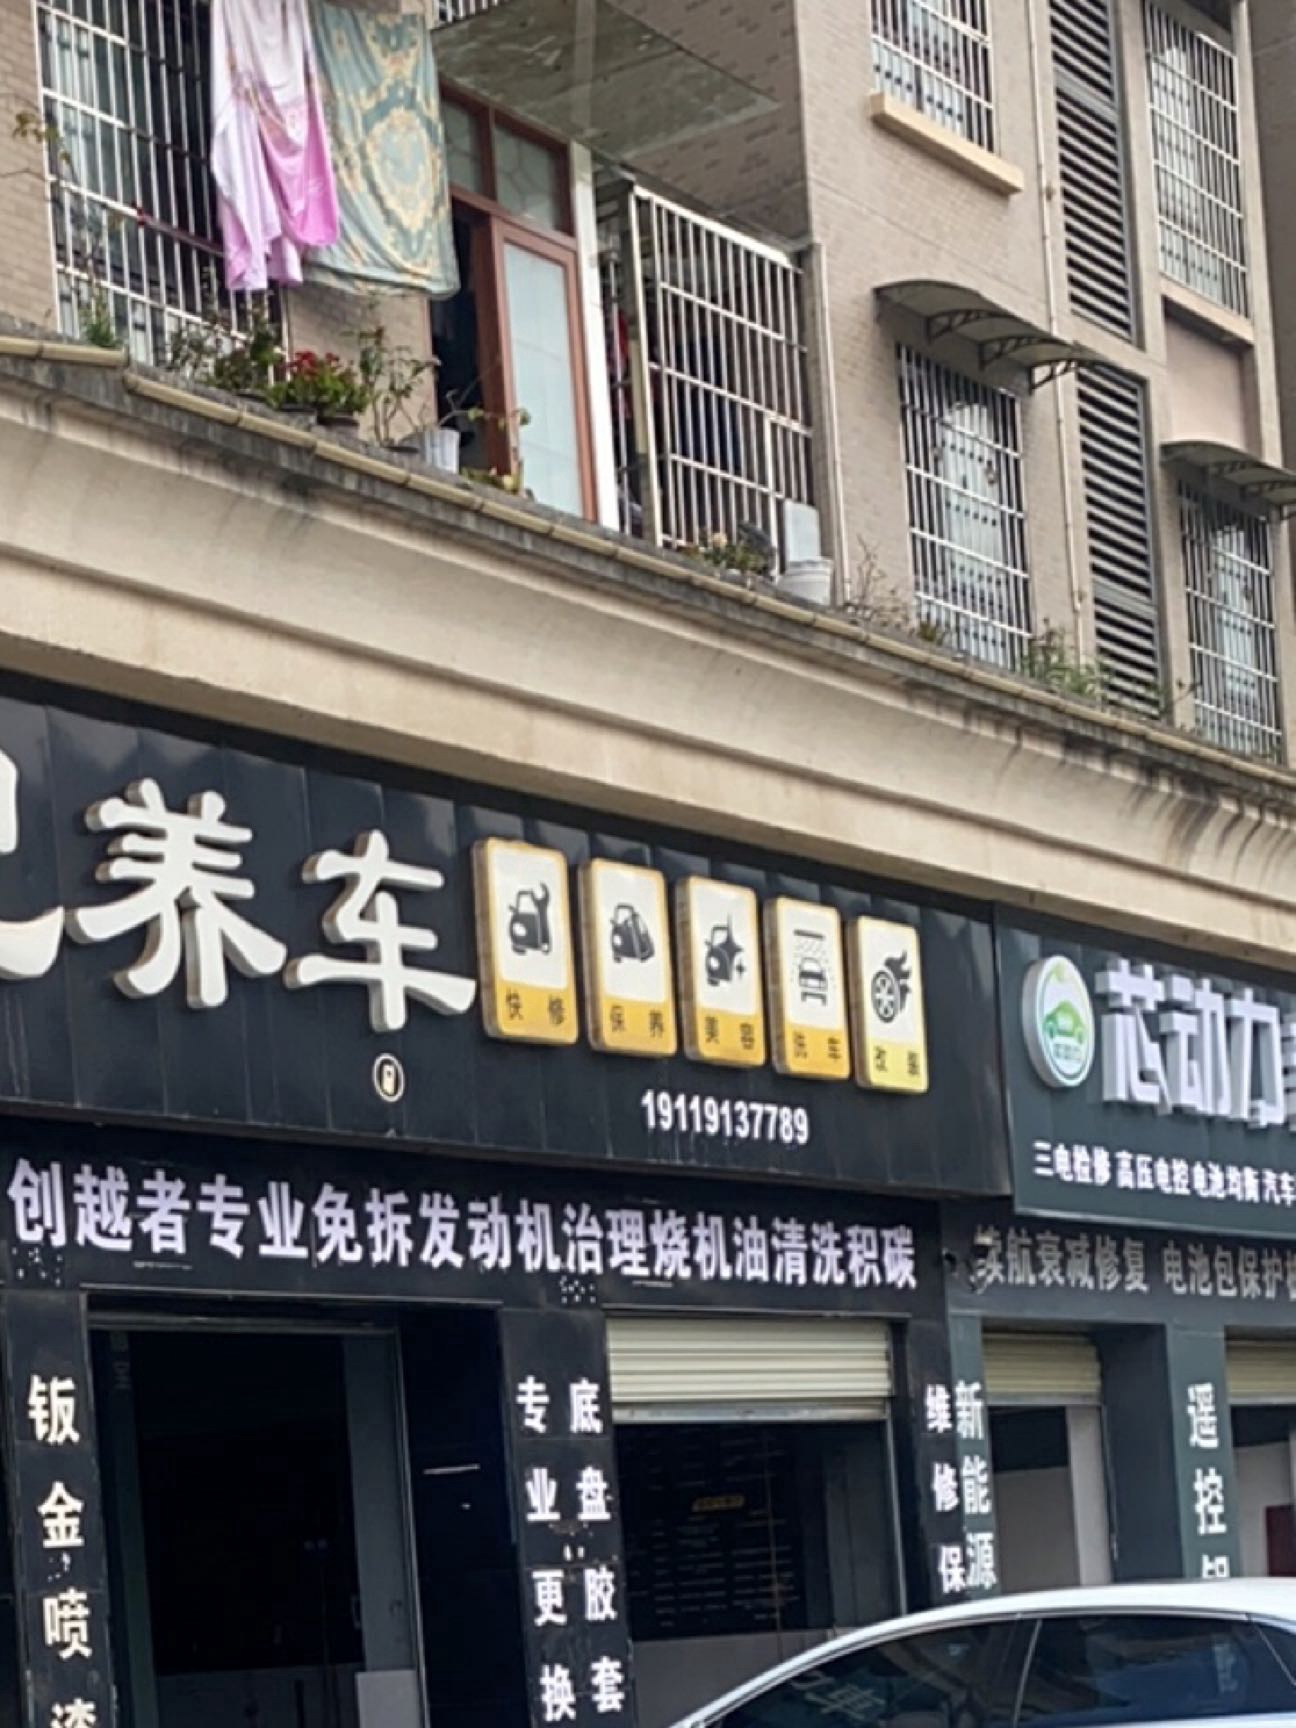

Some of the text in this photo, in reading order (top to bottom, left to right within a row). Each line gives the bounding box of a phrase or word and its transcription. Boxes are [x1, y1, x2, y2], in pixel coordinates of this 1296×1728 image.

[640, 1088, 809, 1145] 19119137789
[1095, 957, 1296, 1133] 芯动力
[515, 1375, 576, 1722] 专业更换
[568, 1377, 625, 1713] 底盘胶套
[954, 1379, 998, 1590] 新能源
